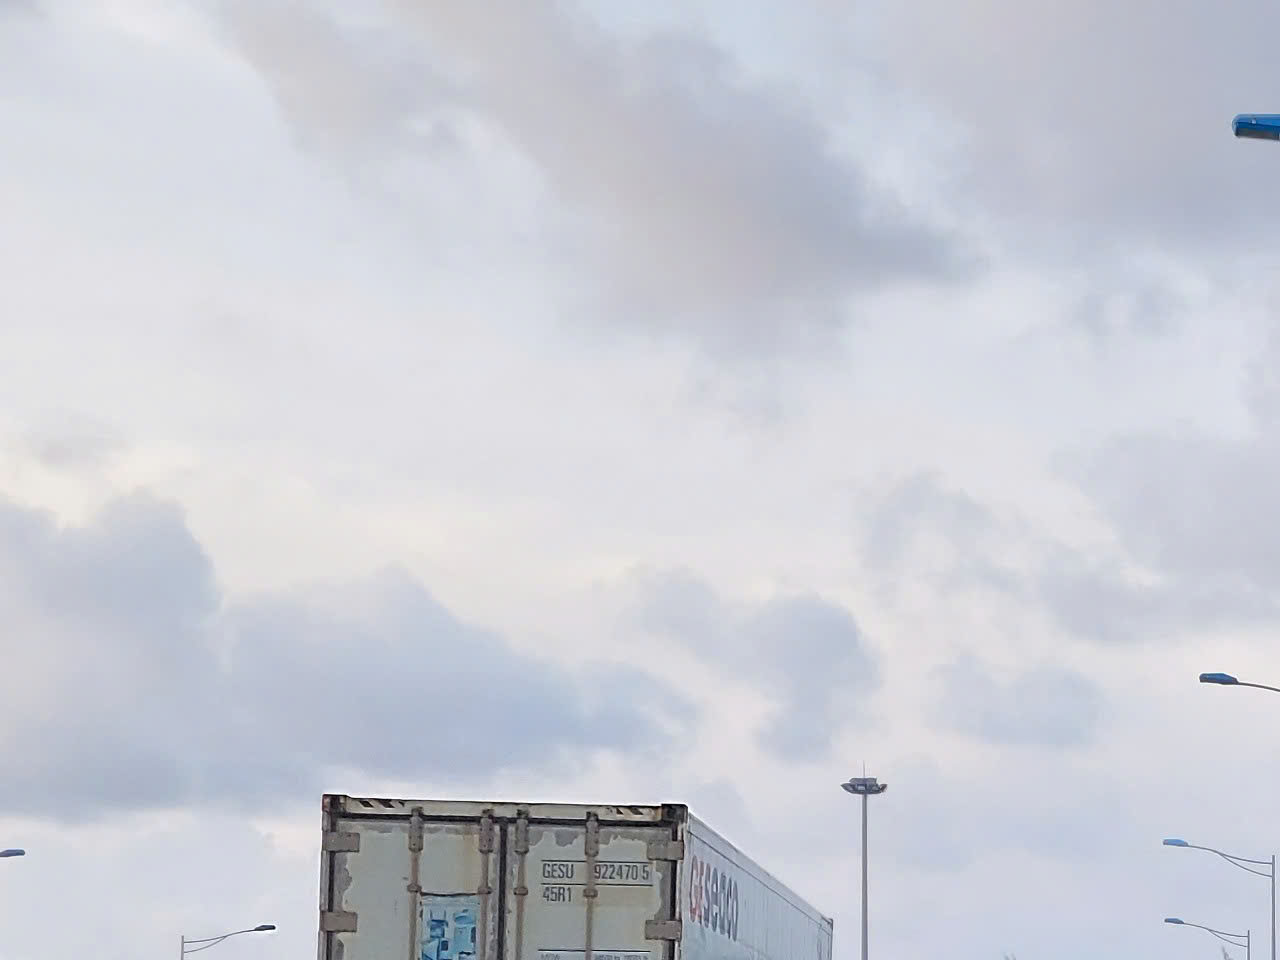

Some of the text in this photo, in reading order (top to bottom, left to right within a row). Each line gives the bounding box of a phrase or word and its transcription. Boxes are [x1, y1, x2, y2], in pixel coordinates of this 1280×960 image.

[542, 863, 650, 880] GESU 922470 5
